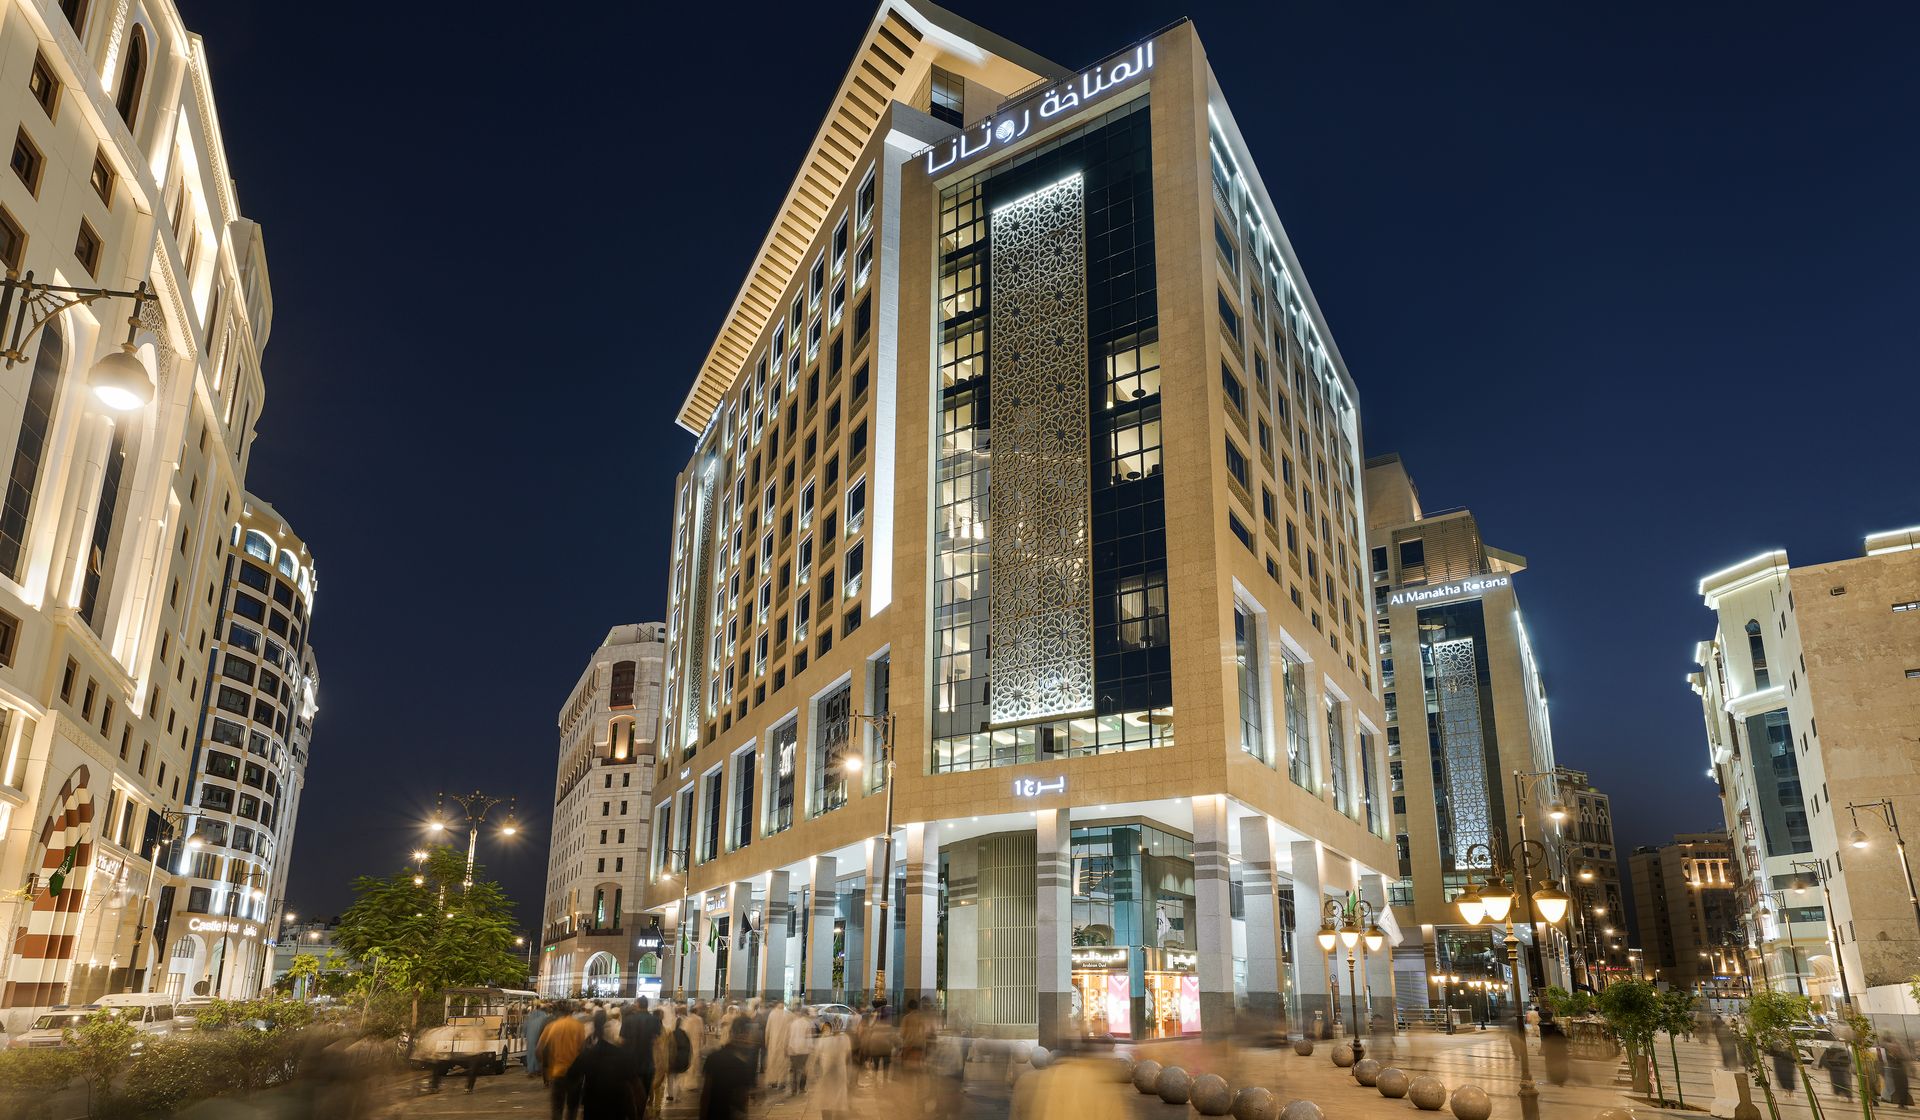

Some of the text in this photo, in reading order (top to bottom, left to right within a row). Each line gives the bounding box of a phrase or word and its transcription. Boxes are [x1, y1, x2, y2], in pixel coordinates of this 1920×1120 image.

[927, 41, 1154, 174] المناخة روتانا
[1390, 577, 1508, 605] Al Manakha Rotana
[189, 918, 222, 932] Castle
